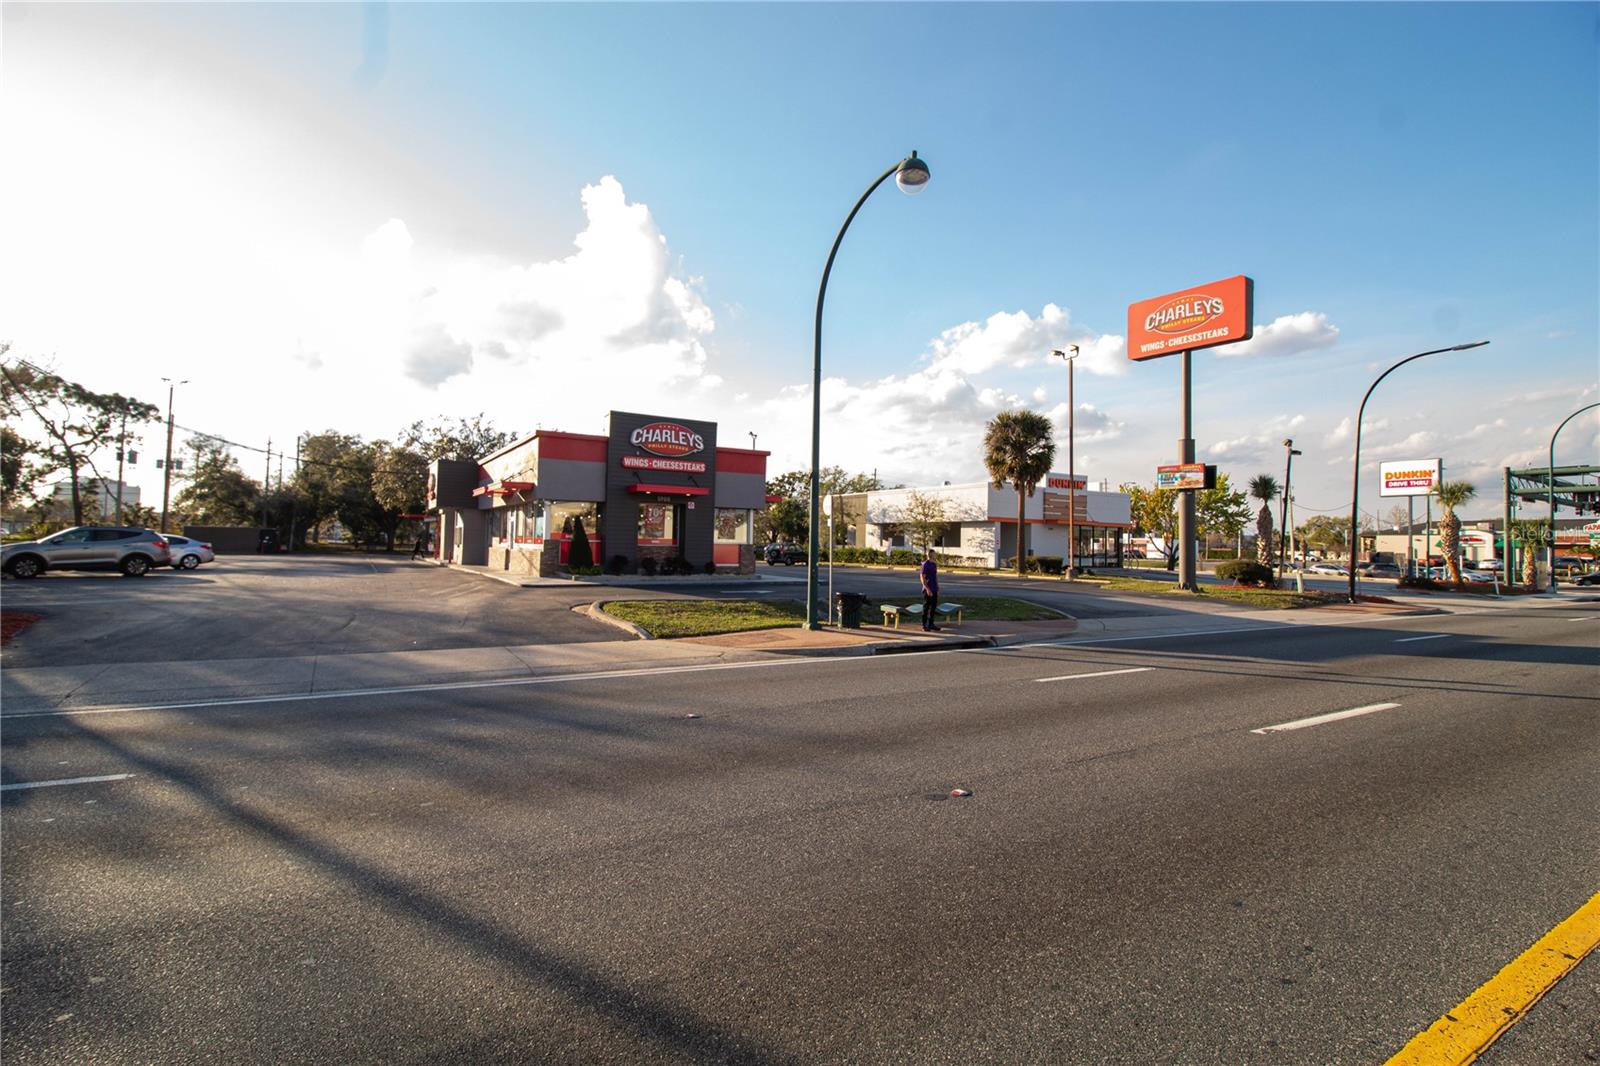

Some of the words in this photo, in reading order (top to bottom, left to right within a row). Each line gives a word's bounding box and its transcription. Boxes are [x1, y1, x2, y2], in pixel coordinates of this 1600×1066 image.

[1145, 298, 1223, 331] CHARLEYS
[1140, 340, 1165, 353] WINGS
[1168, 327, 1229, 347] CHEESESTEAKS
[631, 428, 704, 450] CHARLEYS
[623, 457, 649, 467] WINGS
[652, 459, 706, 472] CHEESESTEAKS
[1385, 469, 1436, 480] DUNKIN'
[1048, 477, 1086, 489] DUNIN'
[1409, 479, 1429, 487] THRU
